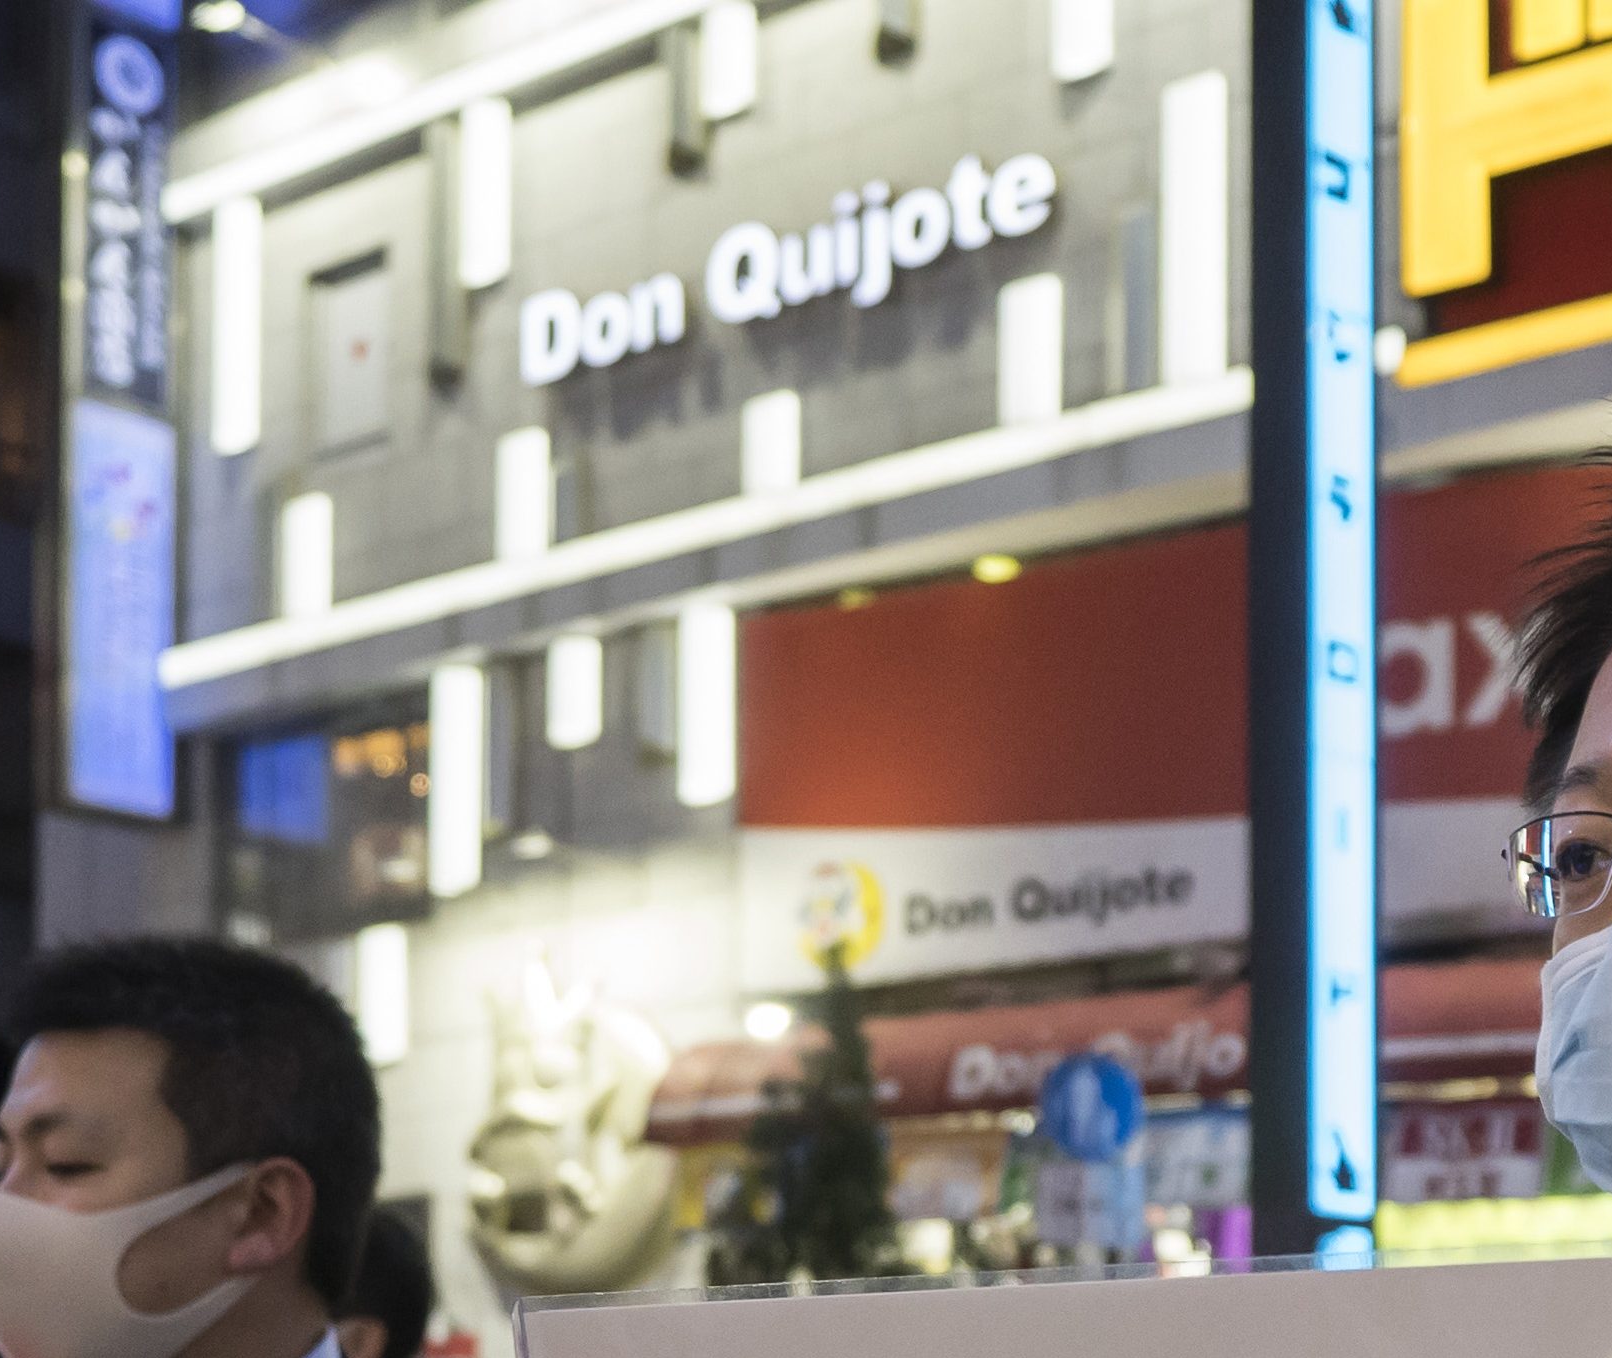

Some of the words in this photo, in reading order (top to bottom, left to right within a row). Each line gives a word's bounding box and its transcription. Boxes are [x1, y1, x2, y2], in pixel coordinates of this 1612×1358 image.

[518, 287, 686, 387] Don
[704, 152, 1058, 324] Quijote
[1377, 612, 1525, 738] ax
[902, 892, 997, 938] Don
[1011, 864, 1197, 925] Quijote
